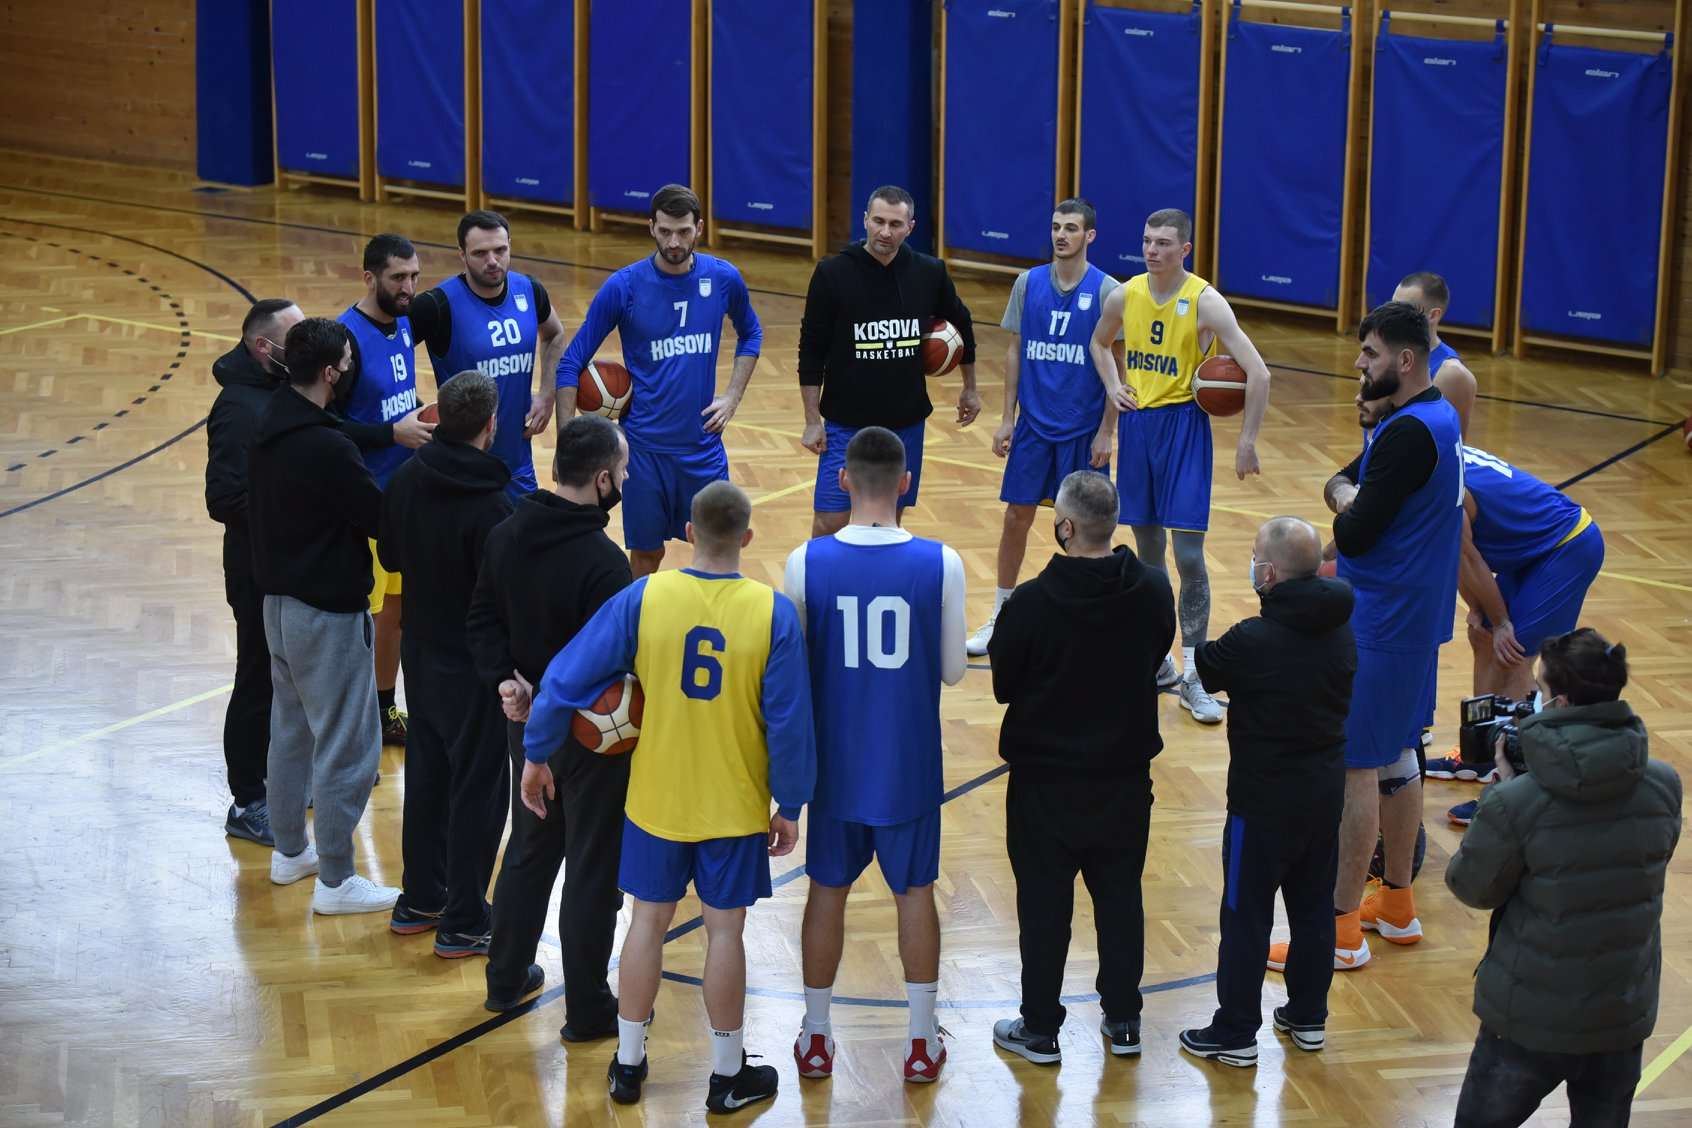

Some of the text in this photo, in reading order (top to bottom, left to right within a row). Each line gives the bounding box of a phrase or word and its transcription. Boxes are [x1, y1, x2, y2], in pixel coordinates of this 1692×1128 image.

[673, 300, 688, 328] 7
[1049, 310, 1071, 336] 17
[488, 318, 521, 347] 20
[853, 318, 920, 341] KOSOVA
[1150, 320, 1164, 345] 9
[390, 353, 407, 383] 19
[836, 595, 911, 669] 10
[680, 625, 726, 701] 6
